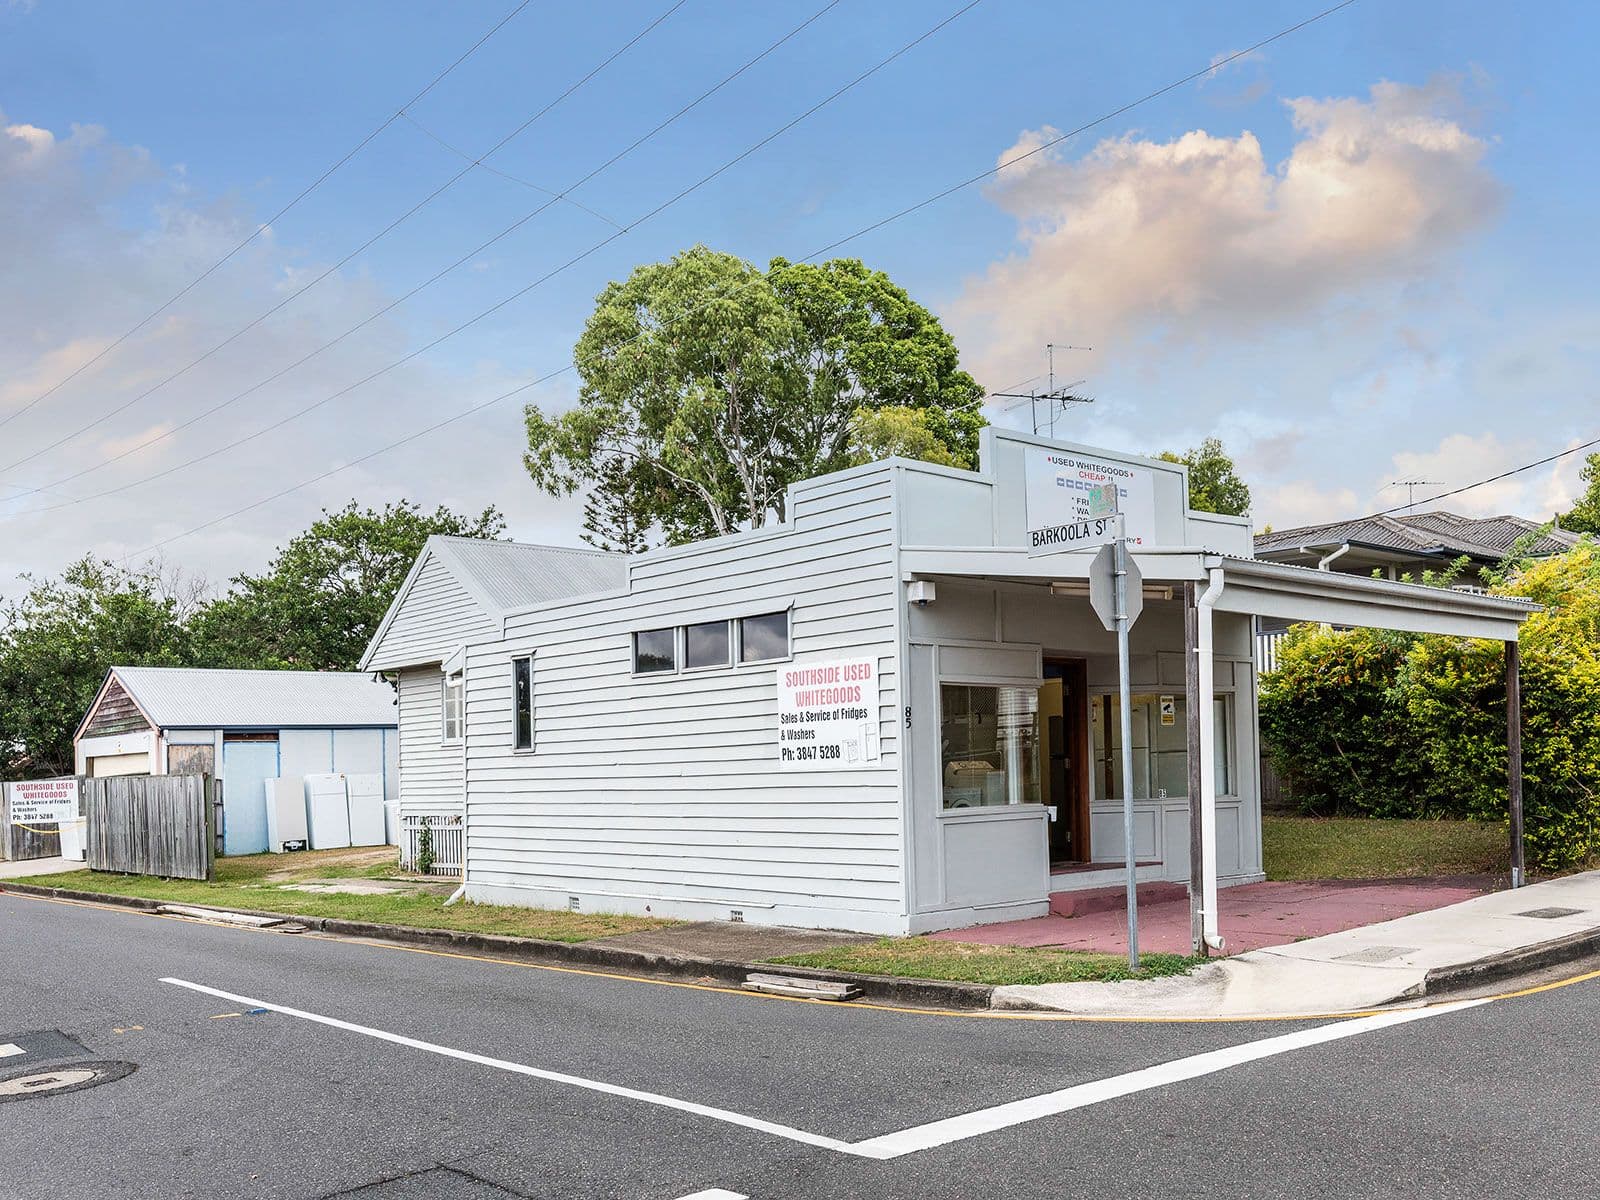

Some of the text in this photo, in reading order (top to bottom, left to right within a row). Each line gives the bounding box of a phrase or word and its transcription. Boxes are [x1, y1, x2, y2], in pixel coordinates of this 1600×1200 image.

[1052, 457, 1129, 477] USED WHITEGOODS
[1079, 471, 1105, 481] CHEAP
[1032, 519, 1107, 547] BARKOOLA ST
[785, 663, 871, 688] SOUTHSIDE USED
[795, 685, 861, 708] WHITEGOODS
[780, 707, 868, 724] Sales & Service of Fridges
[780, 729, 816, 741] & Washers
[781, 744, 841, 761] Ph: 3847 5288
[16, 782, 74, 791] SOUTHSIDE USED
[23, 791, 68, 799] WHITEGOODS
